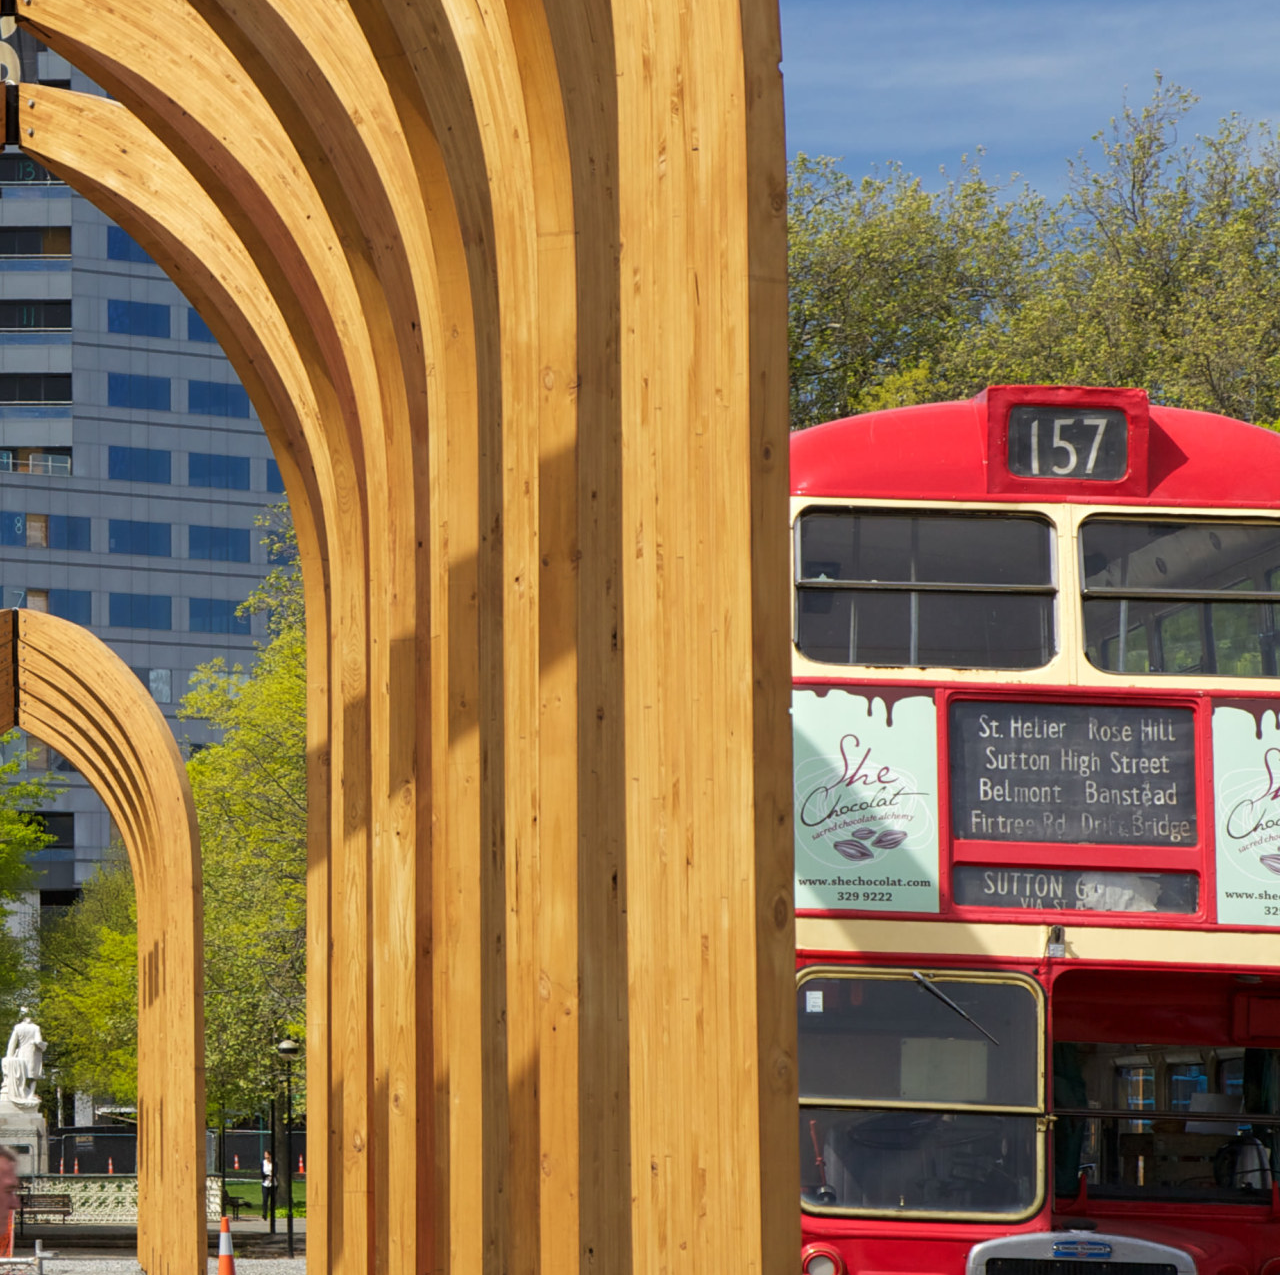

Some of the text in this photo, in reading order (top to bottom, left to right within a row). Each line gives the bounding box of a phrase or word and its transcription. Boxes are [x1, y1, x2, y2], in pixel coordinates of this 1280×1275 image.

[1030, 418, 1108, 475] 157
[978, 714, 1176, 742] St. Helier Rose Hill
[830, 734, 898, 791] She
[985, 746, 1170, 777] Sutton High Street
[800, 785, 930, 827] Chocolat
[979, 777, 1177, 806] Belmont Banstead
[811, 811, 914, 840] sacred chocolate alchemy
[798, 876, 931, 888] www.shechocolat.com
[983, 871, 1063, 898] SUTTON
[837, 892, 893, 903] 329 9222
